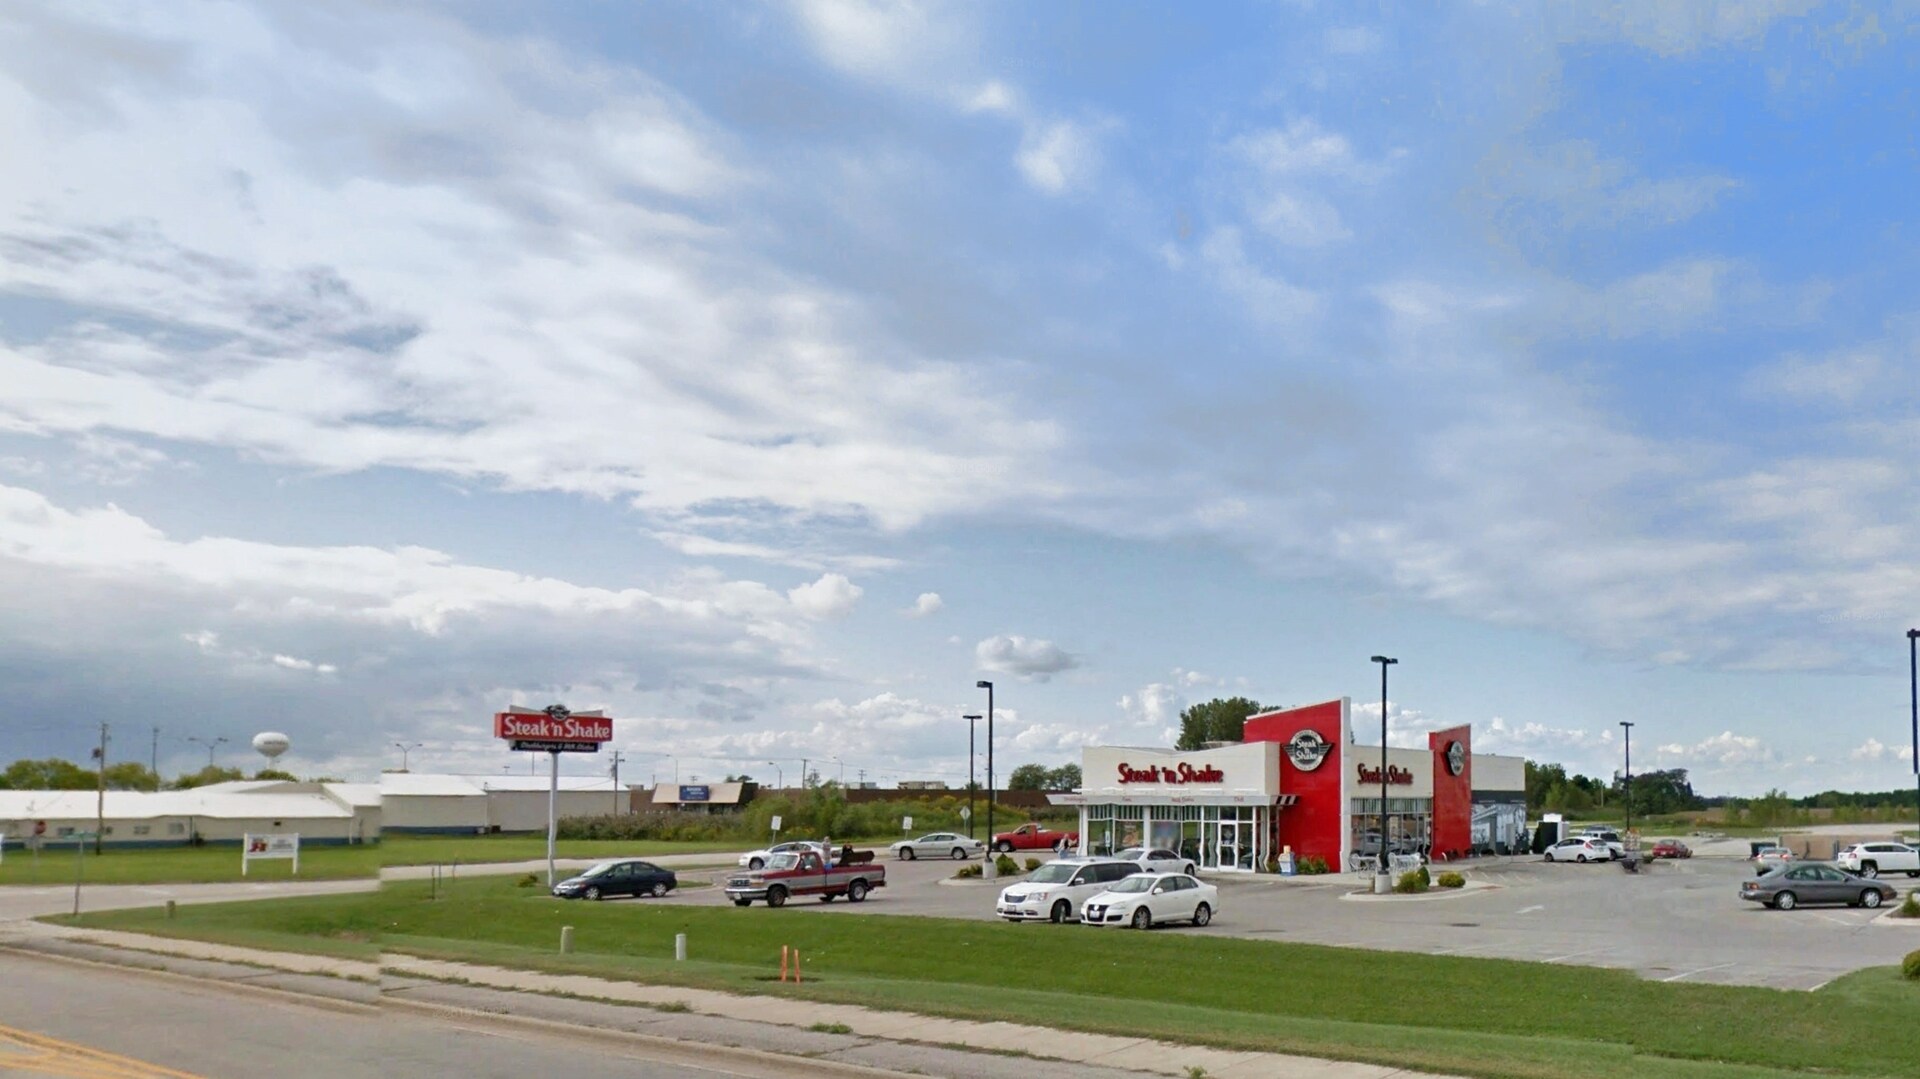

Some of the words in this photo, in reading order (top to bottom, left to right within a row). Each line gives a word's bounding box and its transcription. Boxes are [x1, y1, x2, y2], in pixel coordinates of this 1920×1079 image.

[504, 716, 549, 736] Steak
[565, 718, 610, 738] Shake
[1296, 739, 1317, 749] Steak
[1296, 750, 1318, 760] Shake
[1118, 762, 1160, 783] Steak
[1177, 762, 1224, 784] Shake
